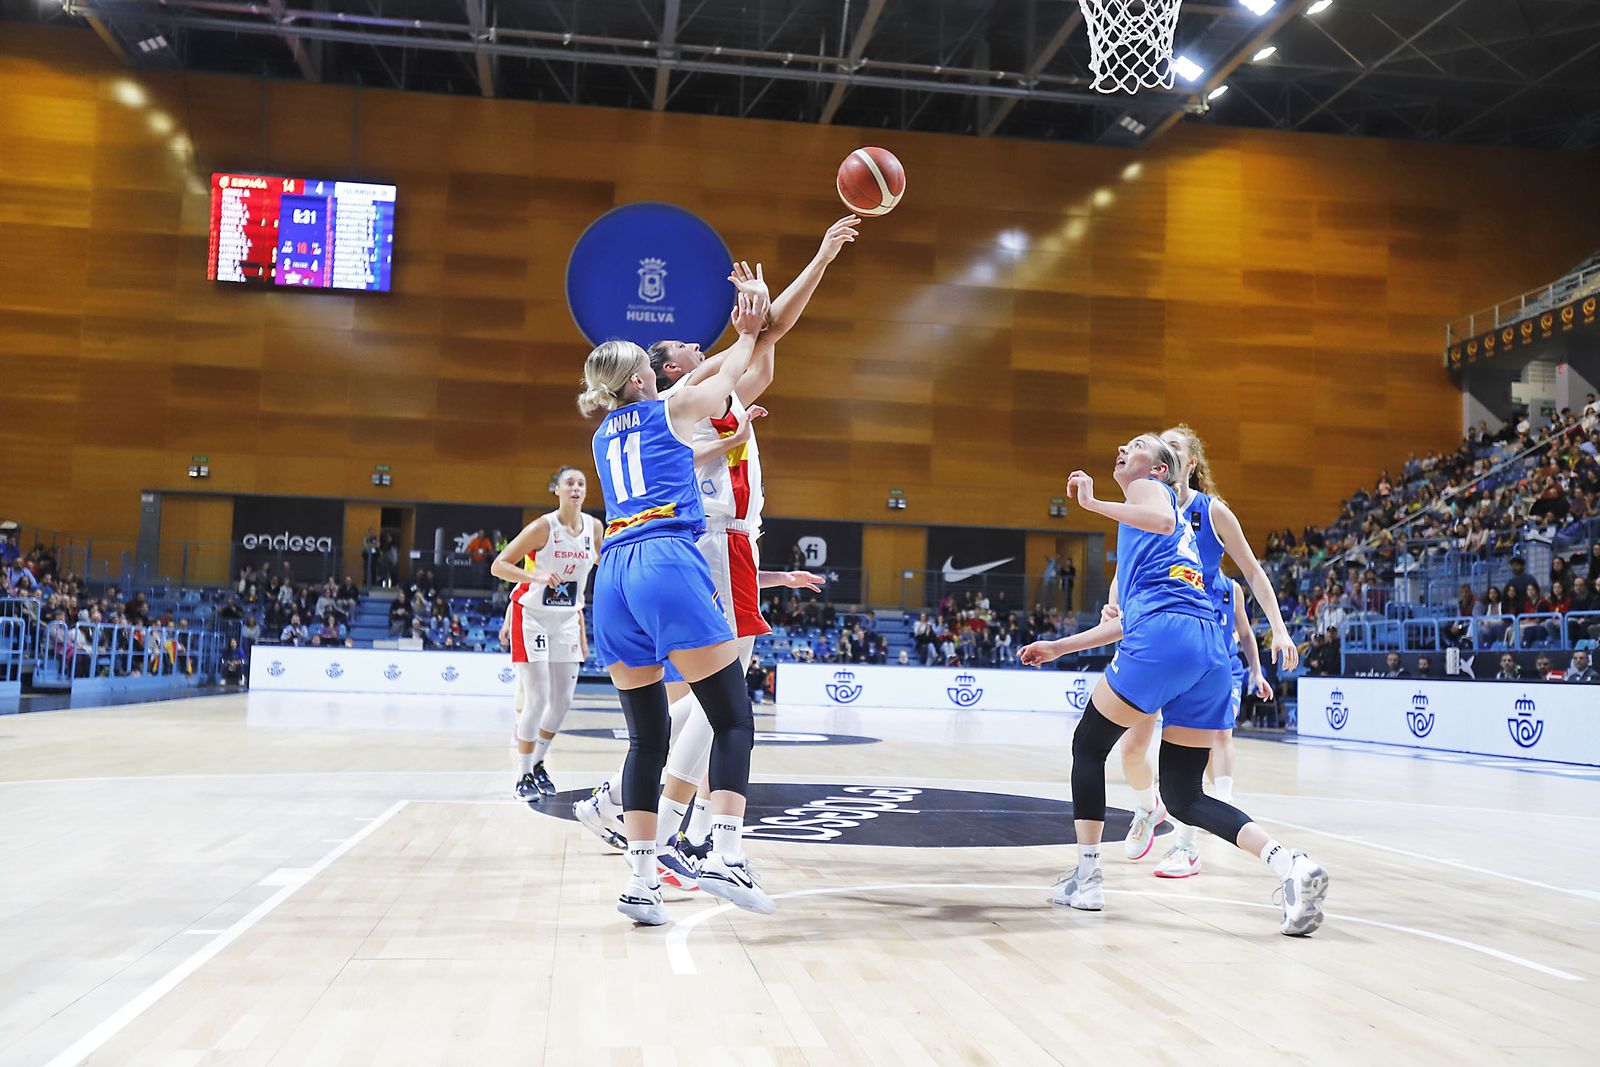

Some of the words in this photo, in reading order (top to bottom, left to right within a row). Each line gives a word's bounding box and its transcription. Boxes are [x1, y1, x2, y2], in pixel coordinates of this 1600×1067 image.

[231, 176, 268, 189] ESPAÑA
[282, 179, 295, 192] 14
[315, 181, 324, 195] 4
[626, 310, 674, 323] HUELVA
[605, 410, 641, 436] ANNA
[606, 431, 647, 504] 11
[242, 531, 332, 553] endesa
[554, 550, 589, 560] ESPAÑA
[713, 822, 736, 832] rrea
